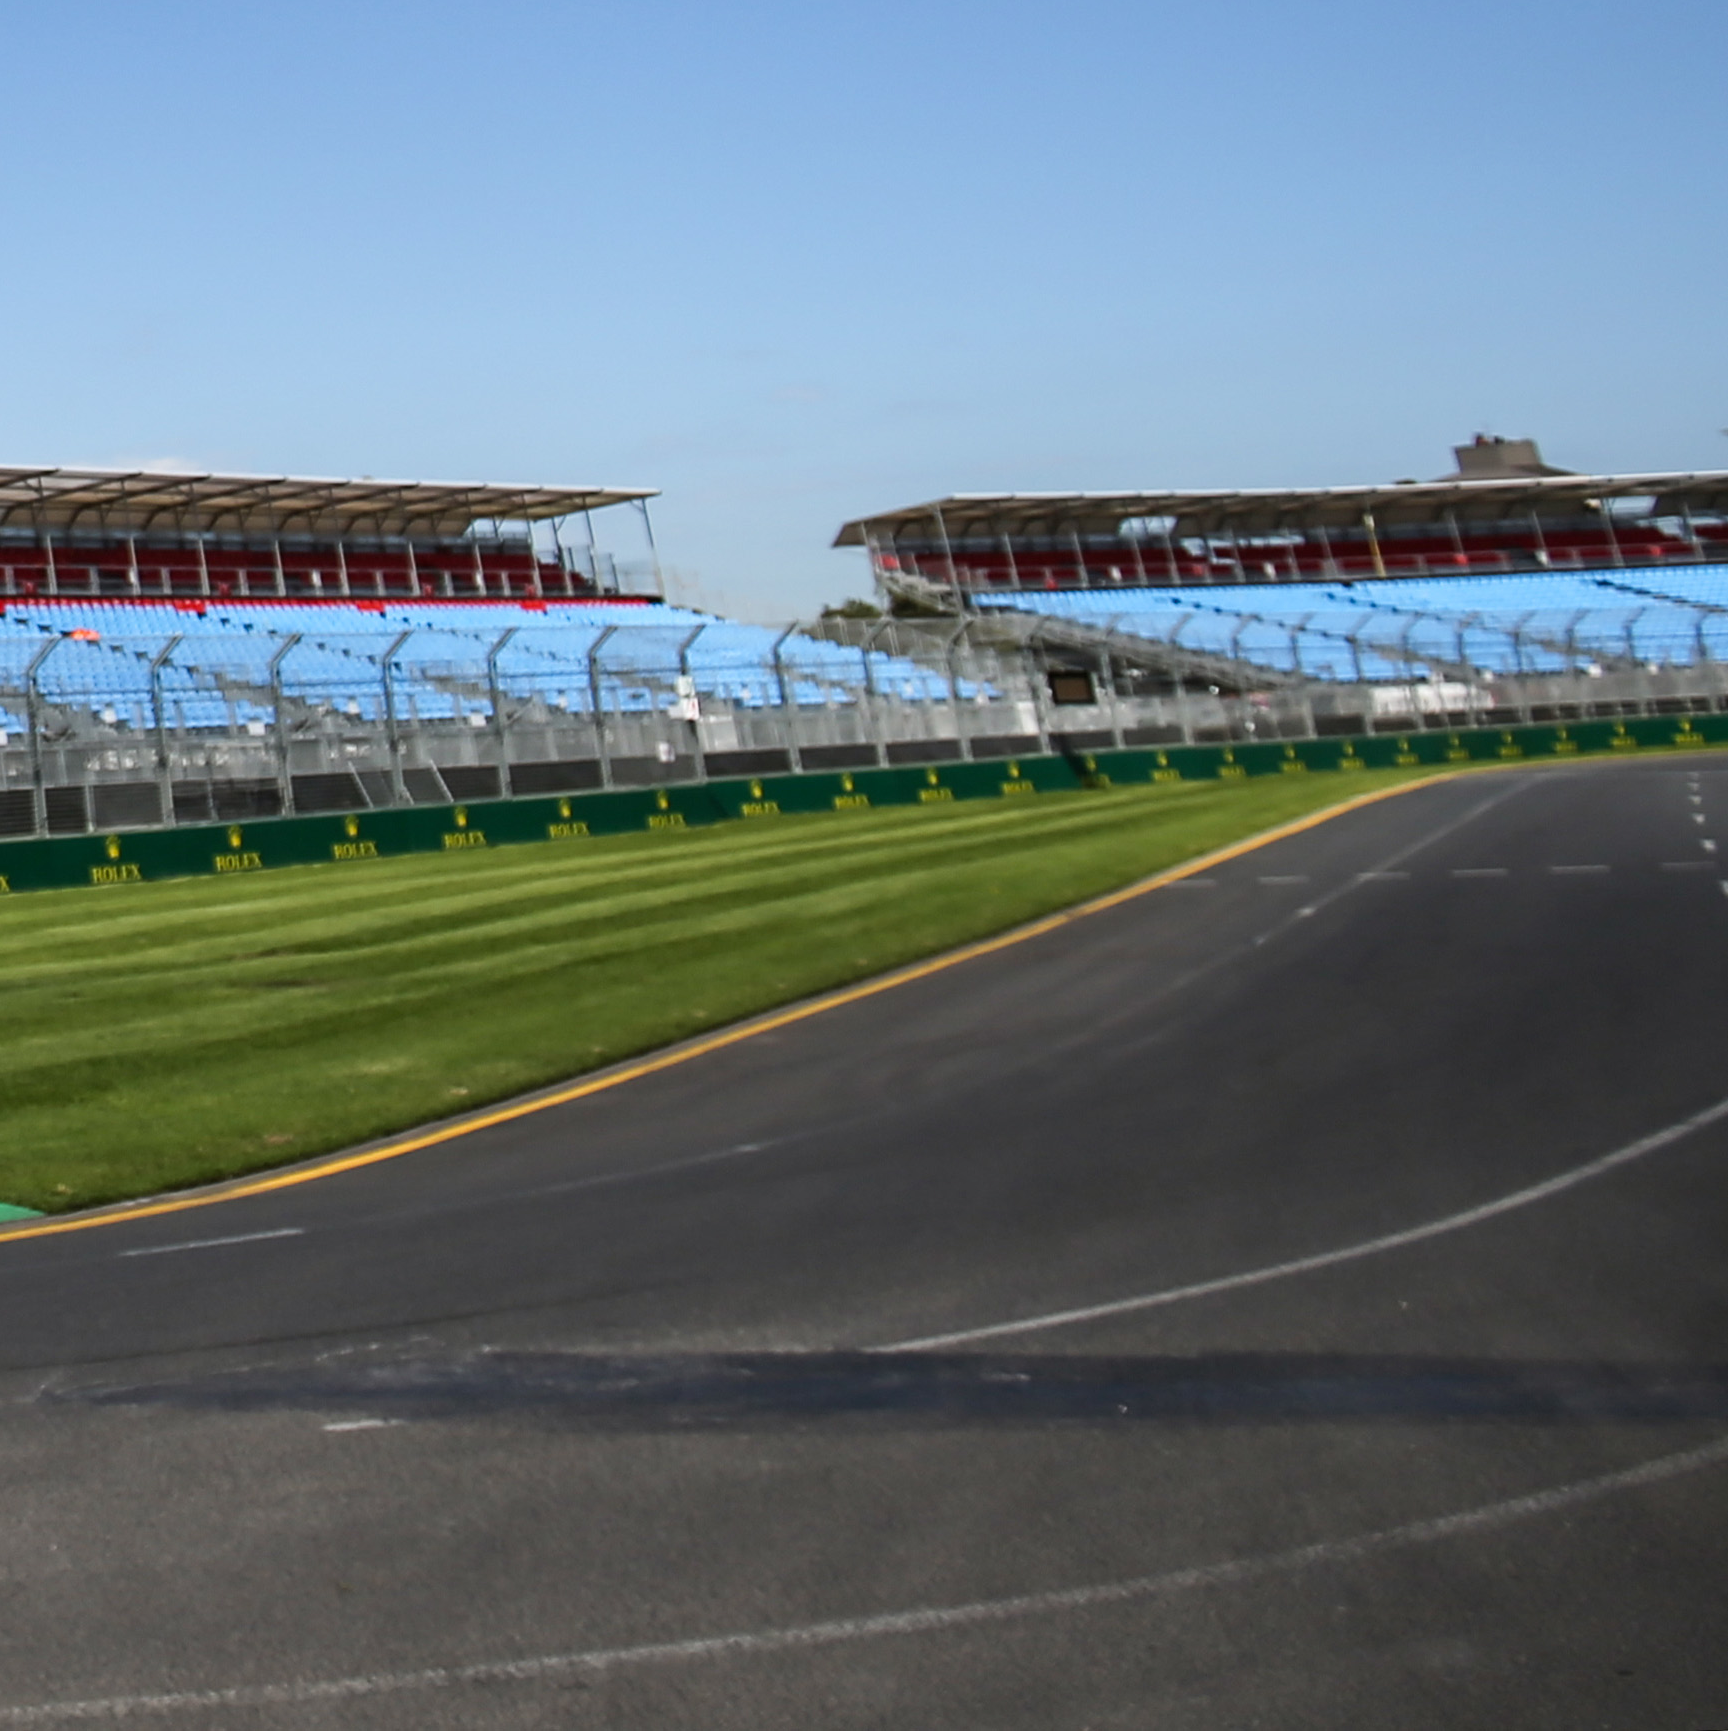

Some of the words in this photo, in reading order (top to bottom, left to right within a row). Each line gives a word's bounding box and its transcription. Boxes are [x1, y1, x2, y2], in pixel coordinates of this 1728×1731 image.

[334, 841, 378, 859] ROLEX
[215, 852, 263, 872] ROLEX
[91, 864, 142, 883] ROLEX
